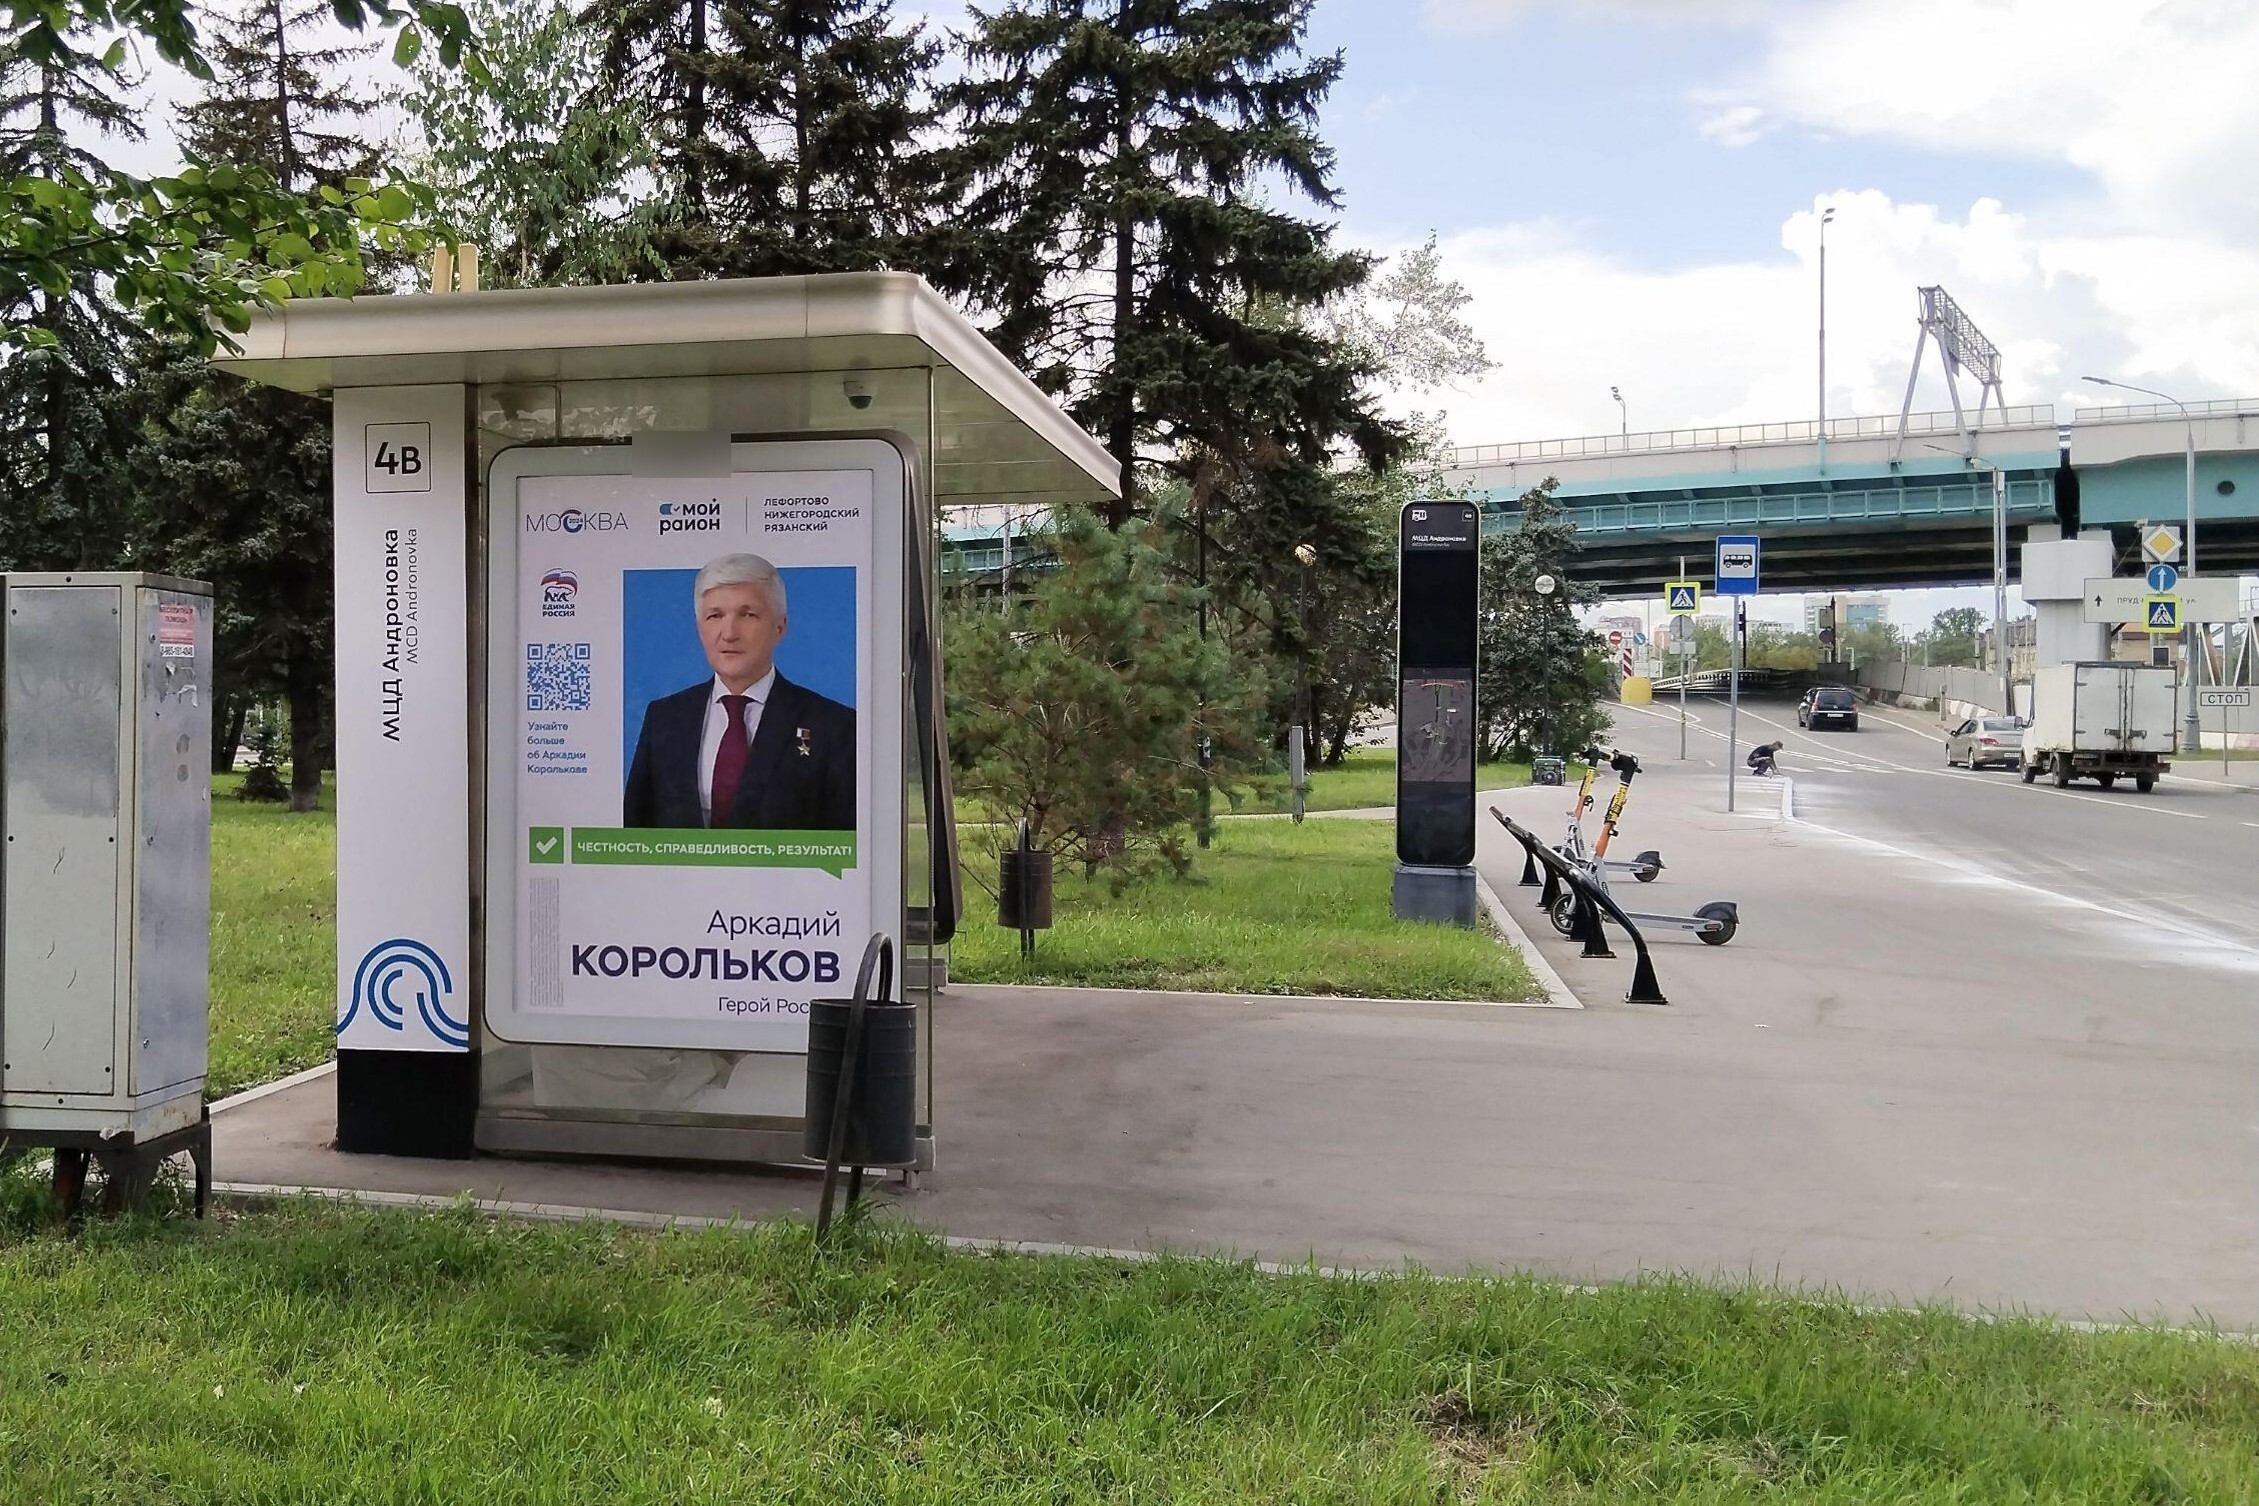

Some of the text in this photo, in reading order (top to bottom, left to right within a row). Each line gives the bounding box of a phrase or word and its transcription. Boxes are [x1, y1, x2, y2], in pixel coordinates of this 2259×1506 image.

[682, 498, 720, 516] мой
[764, 497, 829, 506] ЛЕФОРТОВО
[764, 507, 860, 519] НИЖЕГОРОДСКИЙ
[526, 509, 629, 533] МОСКВА
[764, 521, 828, 532] РЯЗАНСКИЙ
[405, 528, 418, 664] MCD Andronovka
[382, 529, 403, 742] МЦД Андроновка
[2207, 694, 2243, 704] СТОП
[527, 721, 569, 731] Узнайте
[527, 736, 565, 745] больше
[527, 750, 586, 761] об Аркадии
[527, 764, 588, 775] Королькове
[577, 842, 852, 856] ЧЕСТНОСТЬ, СПРАВЕДЛИВОСТЬ, РЕЗУЛЬТАТ!
[706, 909, 841, 940] Аркадий
[571, 944, 841, 983] КОРОЛЬКОВ
[718, 997, 810, 1016] Герой Рос
